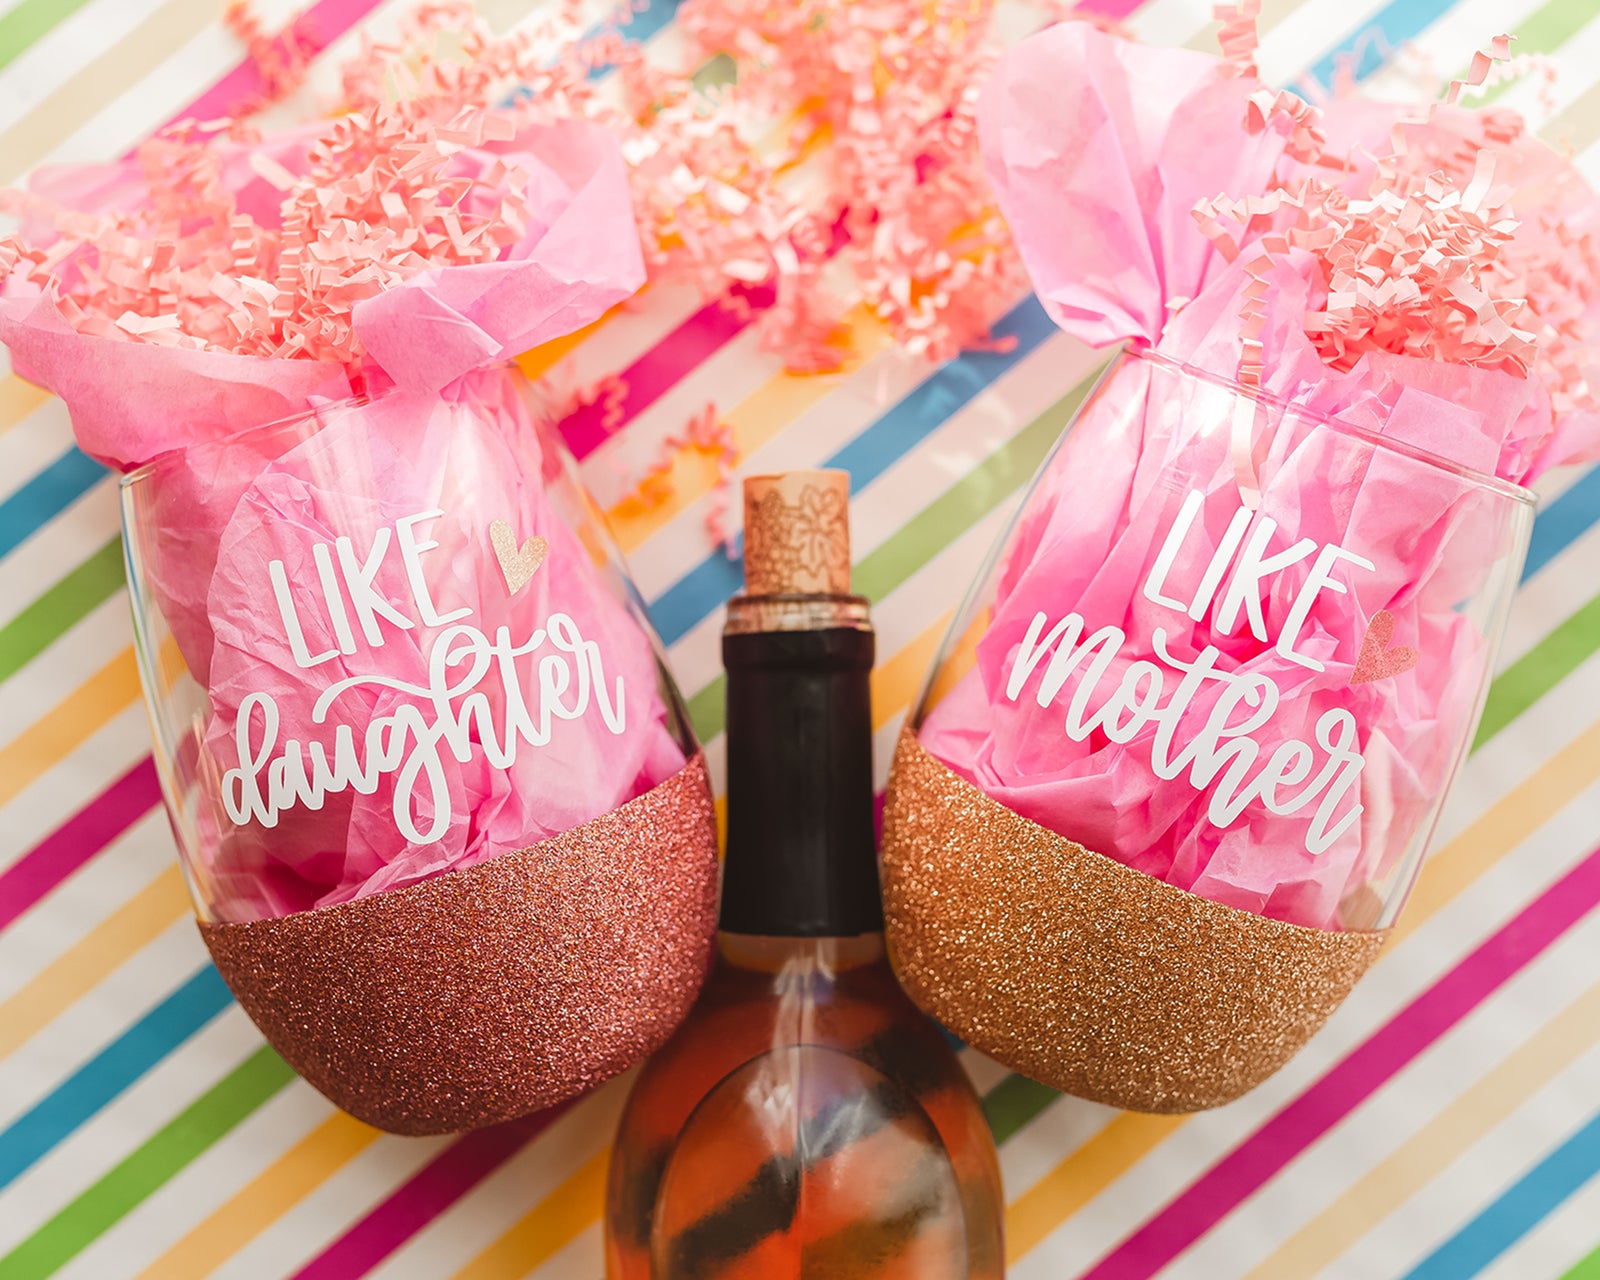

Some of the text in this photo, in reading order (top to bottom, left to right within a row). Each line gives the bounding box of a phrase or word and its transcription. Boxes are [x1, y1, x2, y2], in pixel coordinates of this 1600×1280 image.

[269, 508, 473, 668] LIKE
[1143, 489, 1376, 672] LIKE
[222, 613, 625, 845] daughter
